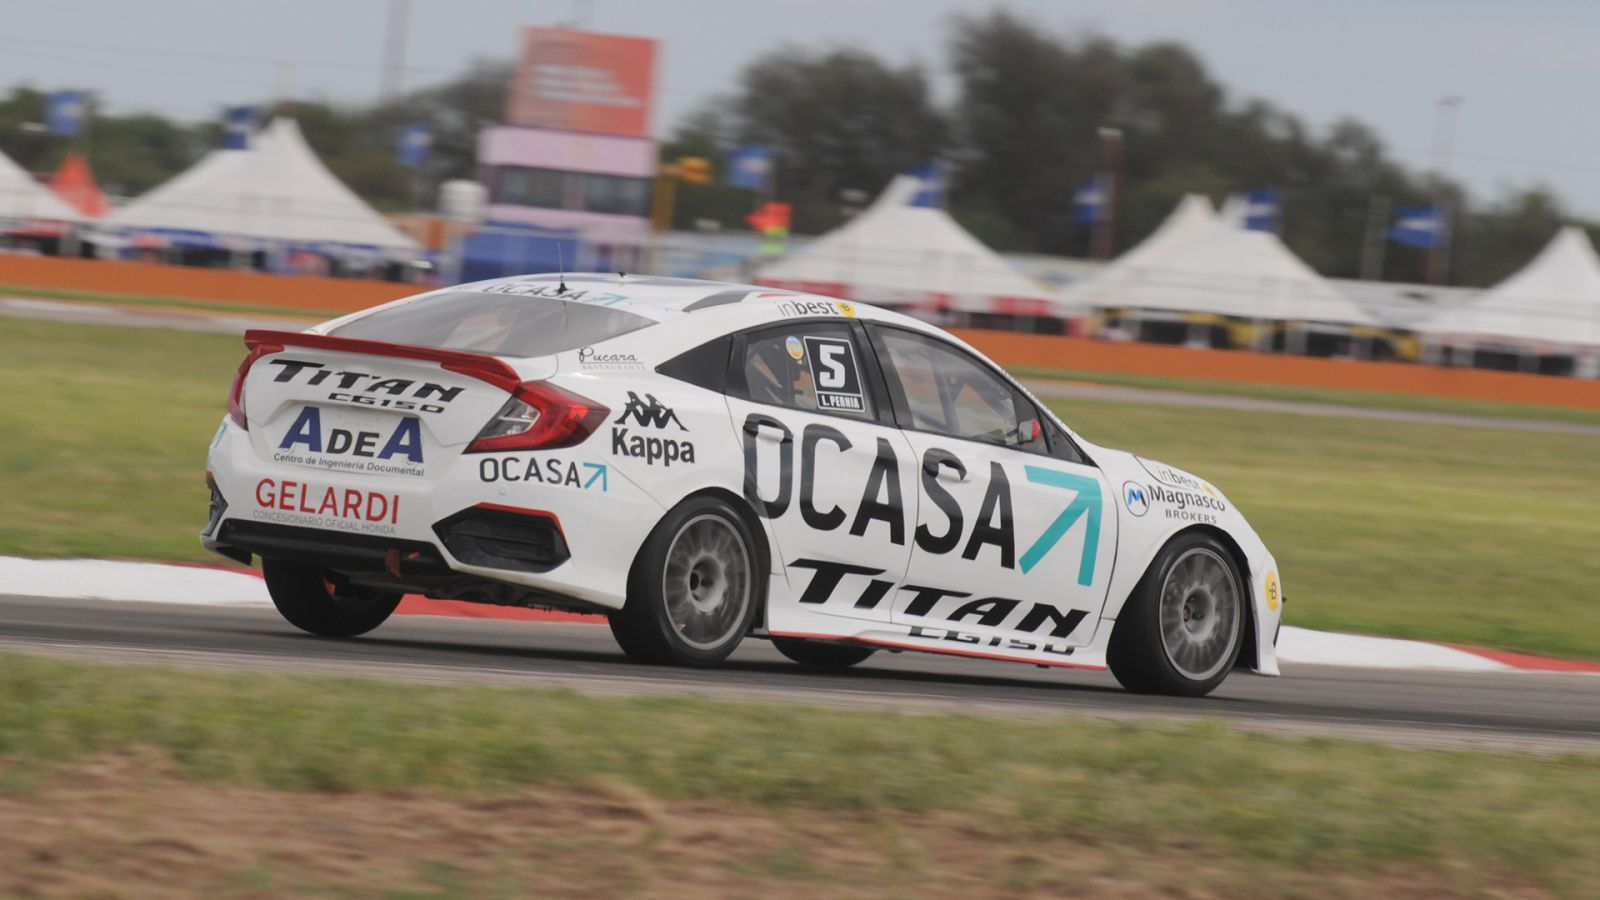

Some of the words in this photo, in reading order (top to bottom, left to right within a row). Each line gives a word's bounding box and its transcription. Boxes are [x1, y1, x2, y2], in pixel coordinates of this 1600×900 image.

[775, 301, 839, 317] inbest
[269, 358, 466, 403] TITAN
[819, 344, 846, 389] 5
[327, 392, 445, 414] CG150
[821, 394, 830, 406] L.
[829, 395, 861, 409] PERNIA
[611, 426, 696, 467] Kappa
[273, 452, 304, 464] Centro
[305, 456, 317, 465] de
[366, 462, 425, 477] Documental
[479, 456, 582, 489] OCASA
[255, 477, 400, 525] GELARDI
[742, 412, 1016, 571] OCASA
[1148, 484, 1226, 512] Magnasco
[252, 509, 323, 527] CONCESIONARIO
[325, 518, 359, 530] OFICIAL
[361, 523, 396, 535] HONDA
[1165, 508, 1217, 525] BROKERS
[786, 557, 1091, 639] TITAN
